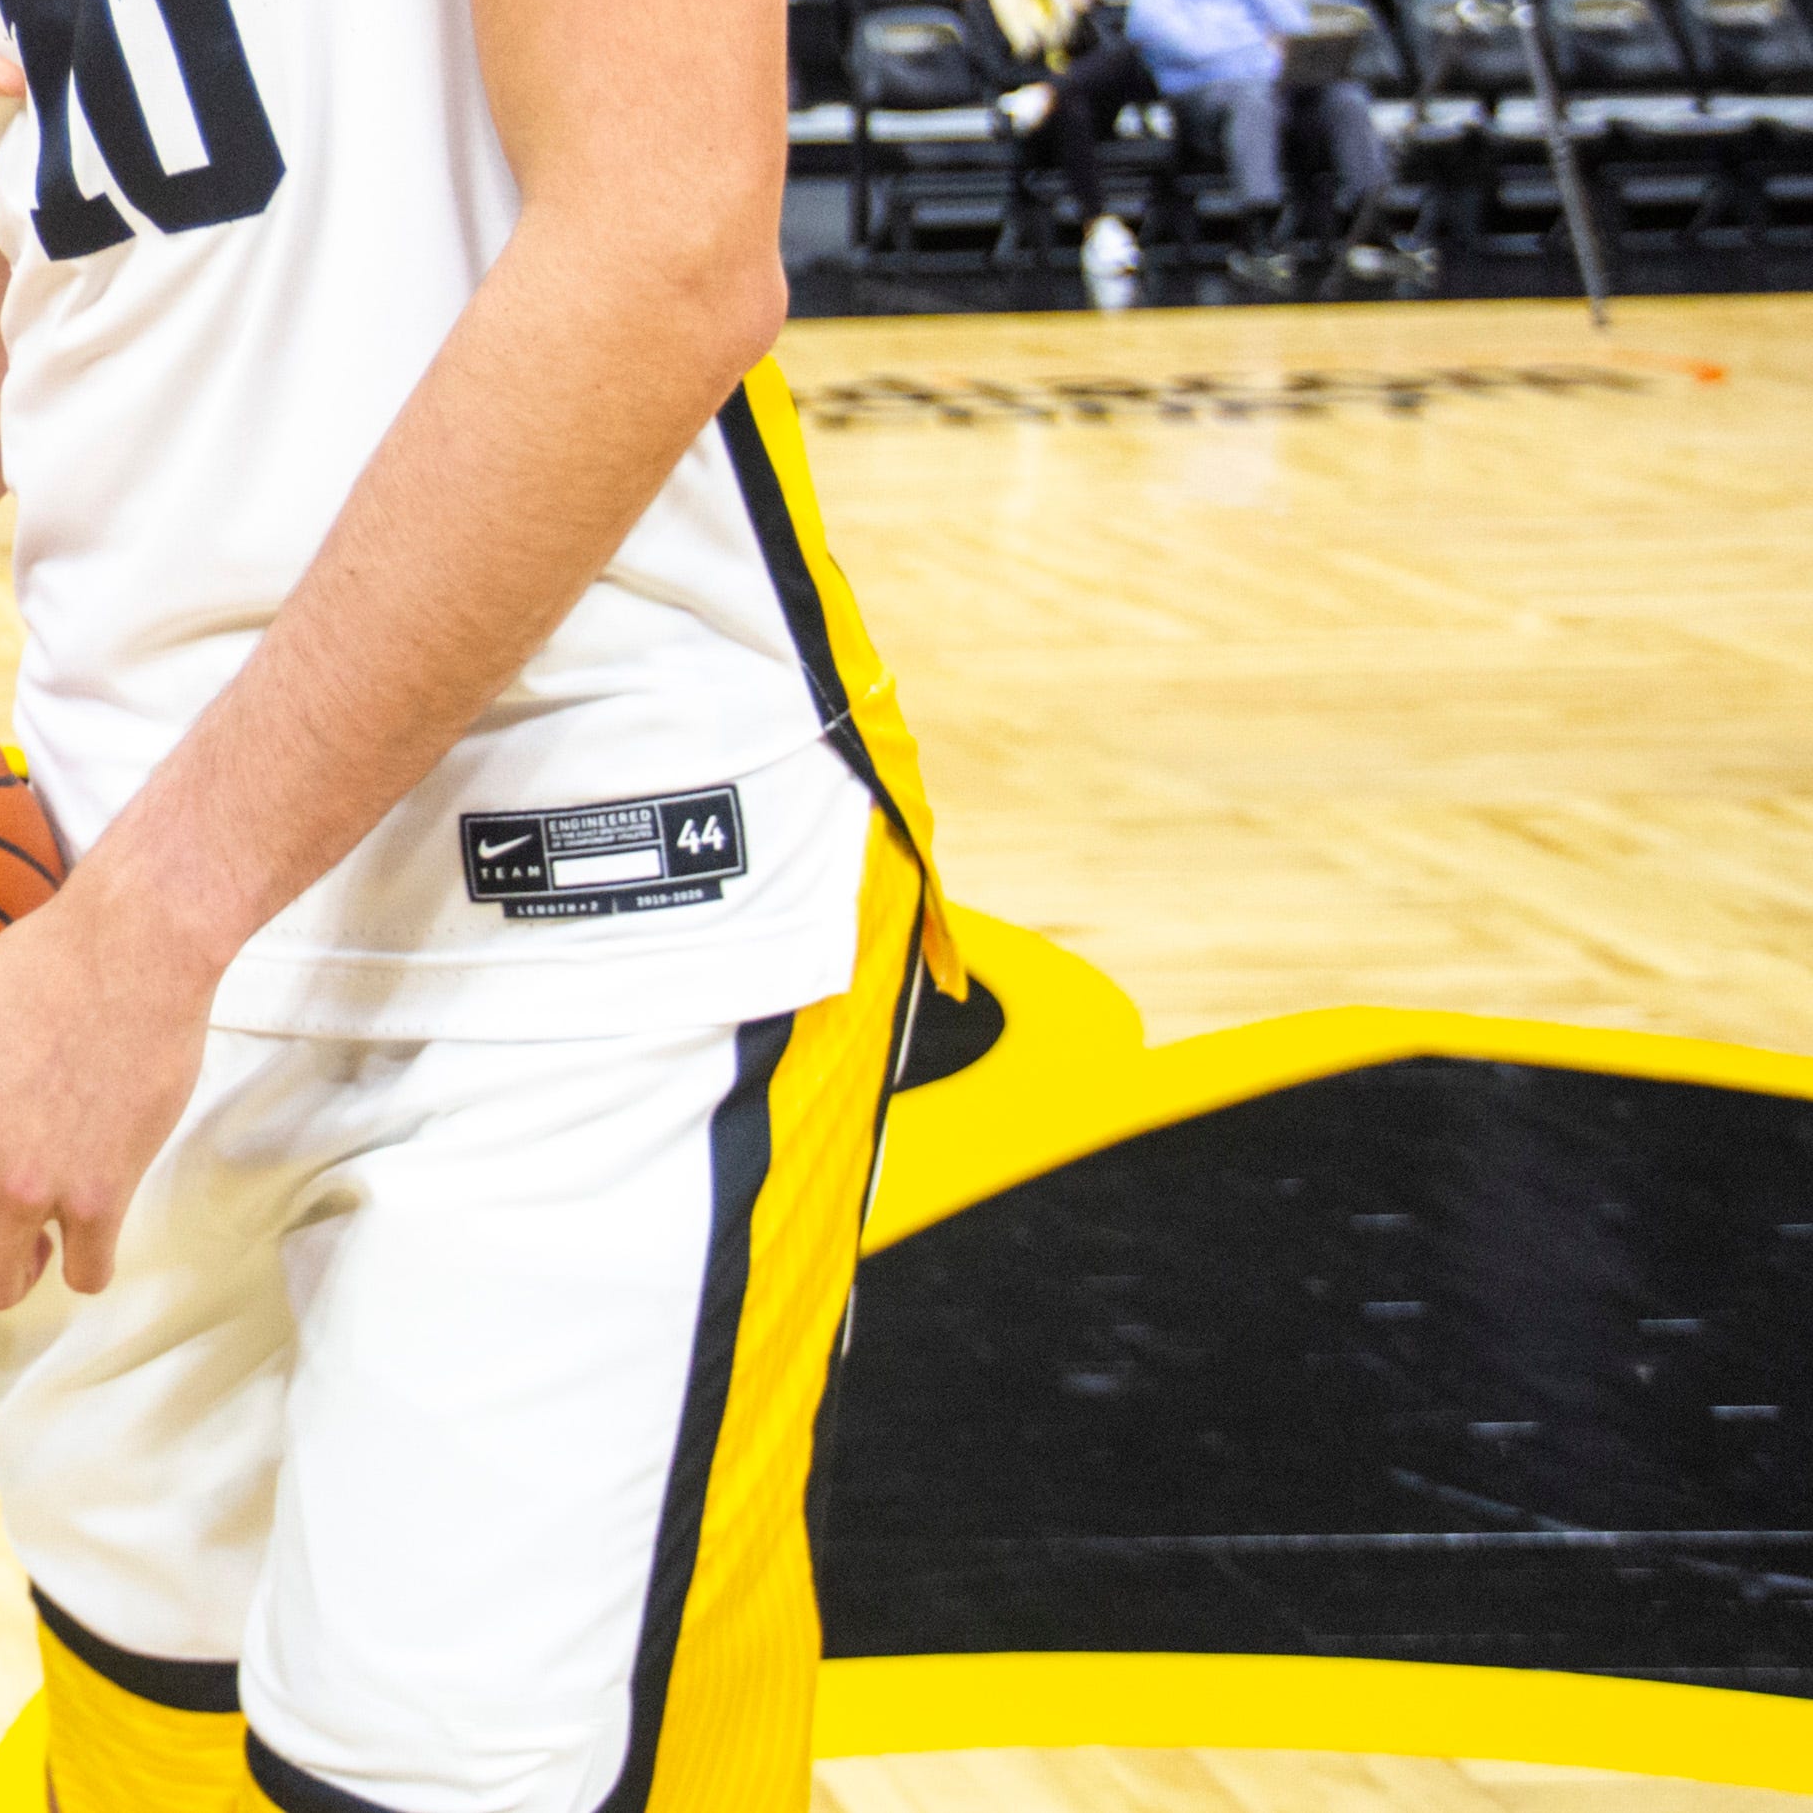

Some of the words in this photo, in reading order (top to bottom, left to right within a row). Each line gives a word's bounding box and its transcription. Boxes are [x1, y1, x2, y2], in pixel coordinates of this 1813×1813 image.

[548, 808, 653, 832] ENGINEERED
[676, 814, 725, 854] 44
[479, 865, 541, 880] TEAM
